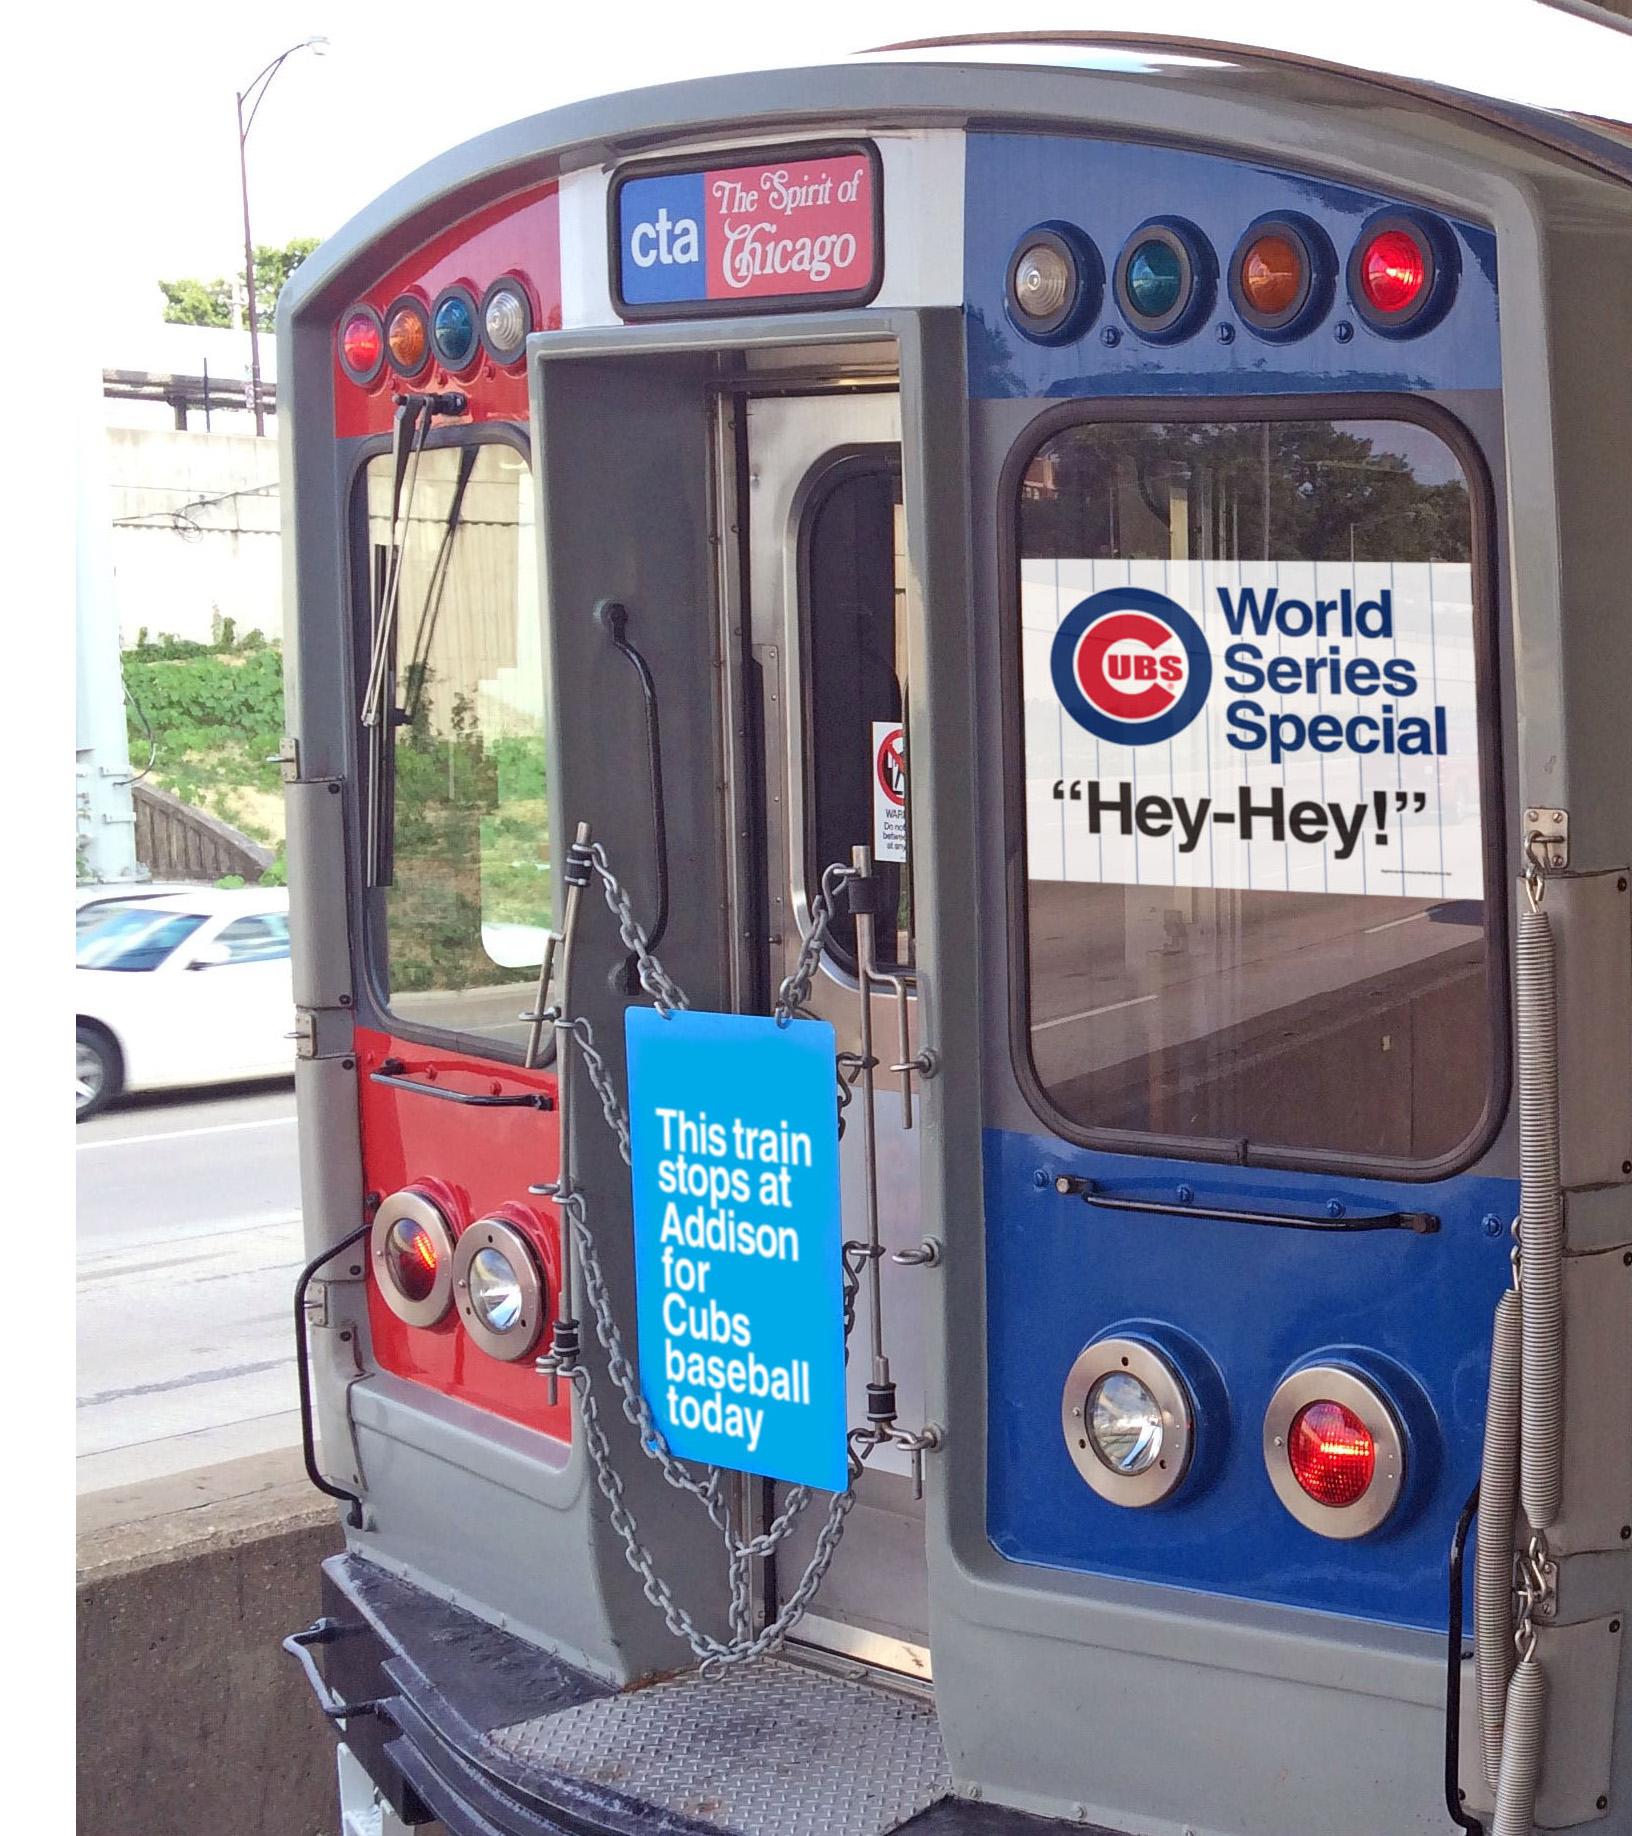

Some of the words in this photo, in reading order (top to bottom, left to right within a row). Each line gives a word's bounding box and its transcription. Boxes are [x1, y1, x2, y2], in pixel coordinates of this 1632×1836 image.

[712, 181, 758, 214] The
[761, 170, 833, 215] Spirit
[837, 169, 864, 203] of
[631, 208, 699, 268] cta
[722, 219, 857, 289] Chicago
[1217, 587, 1393, 639] World
[1224, 643, 1418, 696] Series
[1225, 700, 1447, 764] Special
[655, 1108, 727, 1157] This
[732, 1117, 812, 1166] train
[658, 1157, 750, 1208] stops
[759, 1166, 792, 1208] at
[660, 1203, 799, 1261] Addison
[662, 1247, 711, 1293] for
[662, 1293, 751, 1347] Cubs
[665, 1339, 811, 1404] baseball
[667, 1385, 764, 1452] today
